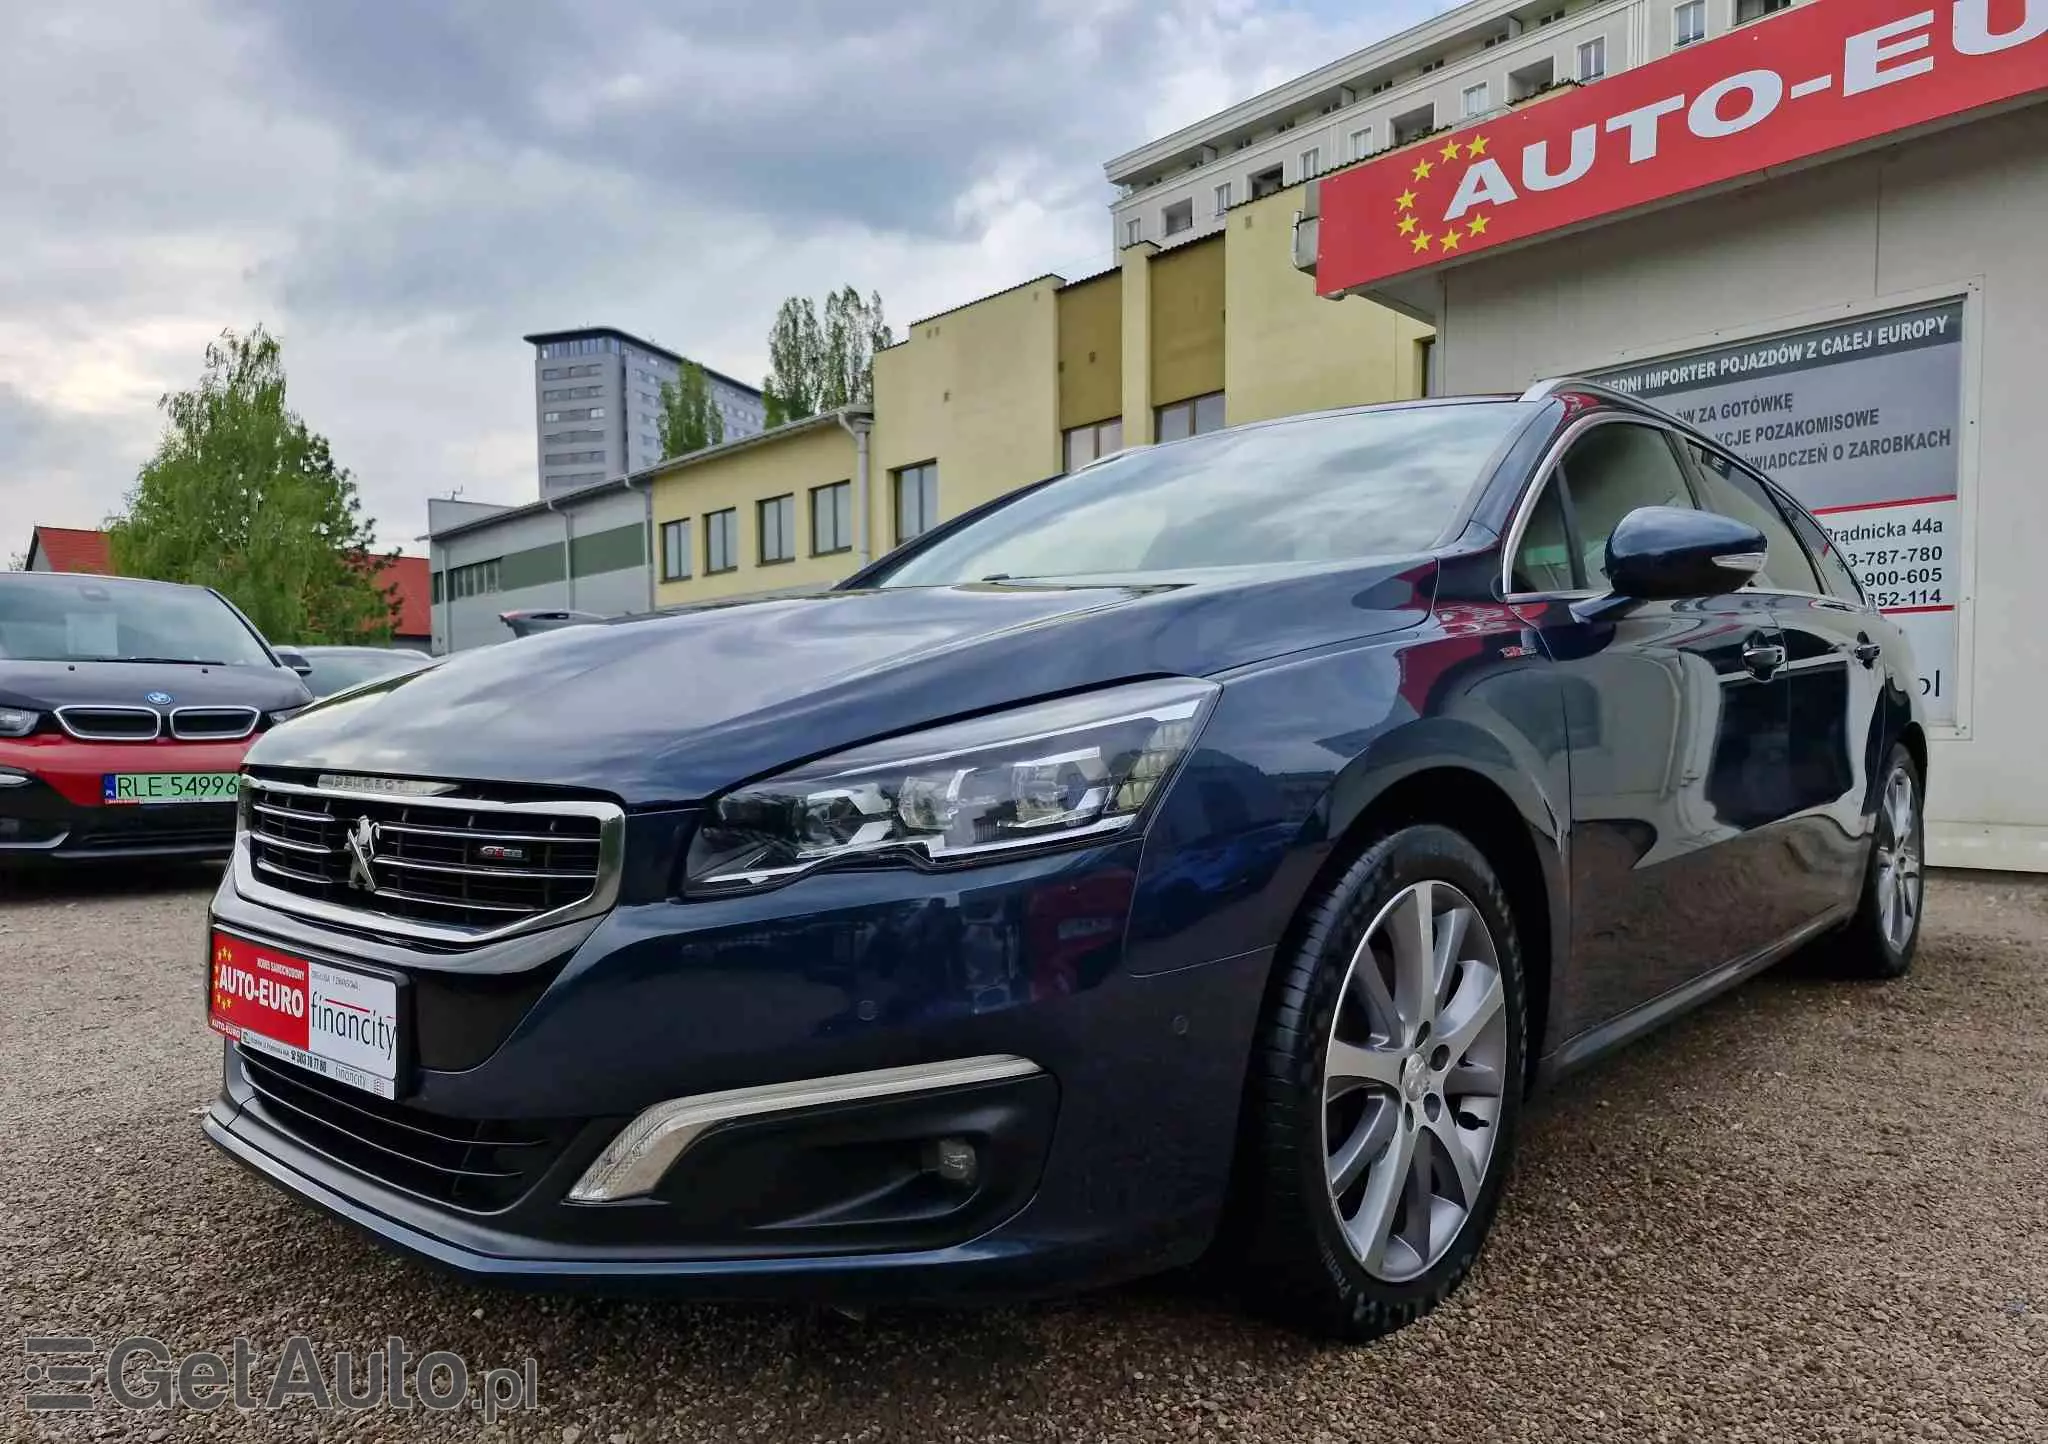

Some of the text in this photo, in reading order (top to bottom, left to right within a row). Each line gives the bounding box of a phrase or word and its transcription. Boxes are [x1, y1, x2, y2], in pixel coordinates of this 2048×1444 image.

[1645, 360, 1717, 388] IMPORTER
[1720, 344, 1803, 375] POJAZDÓW
[1807, 341, 1818, 360] Z
[1821, 330, 1873, 356] CAŁEJ
[1877, 315, 1949, 346] EUROPY
[1698, 405, 1717, 424] ZA
[1720, 392, 1794, 419] GOTÓWKĘ
[1754, 408, 1880, 443] POZAKOMISOWE
[1832, 444, 1844, 461] O
[1849, 428, 1952, 460] ZAROBKACH
[1911, 517, 1944, 536] 44a
[117, 775, 238, 797] RLE 54996
[219, 964, 304, 1018] AUTO-EURO
[310, 990, 396, 1061] financity
